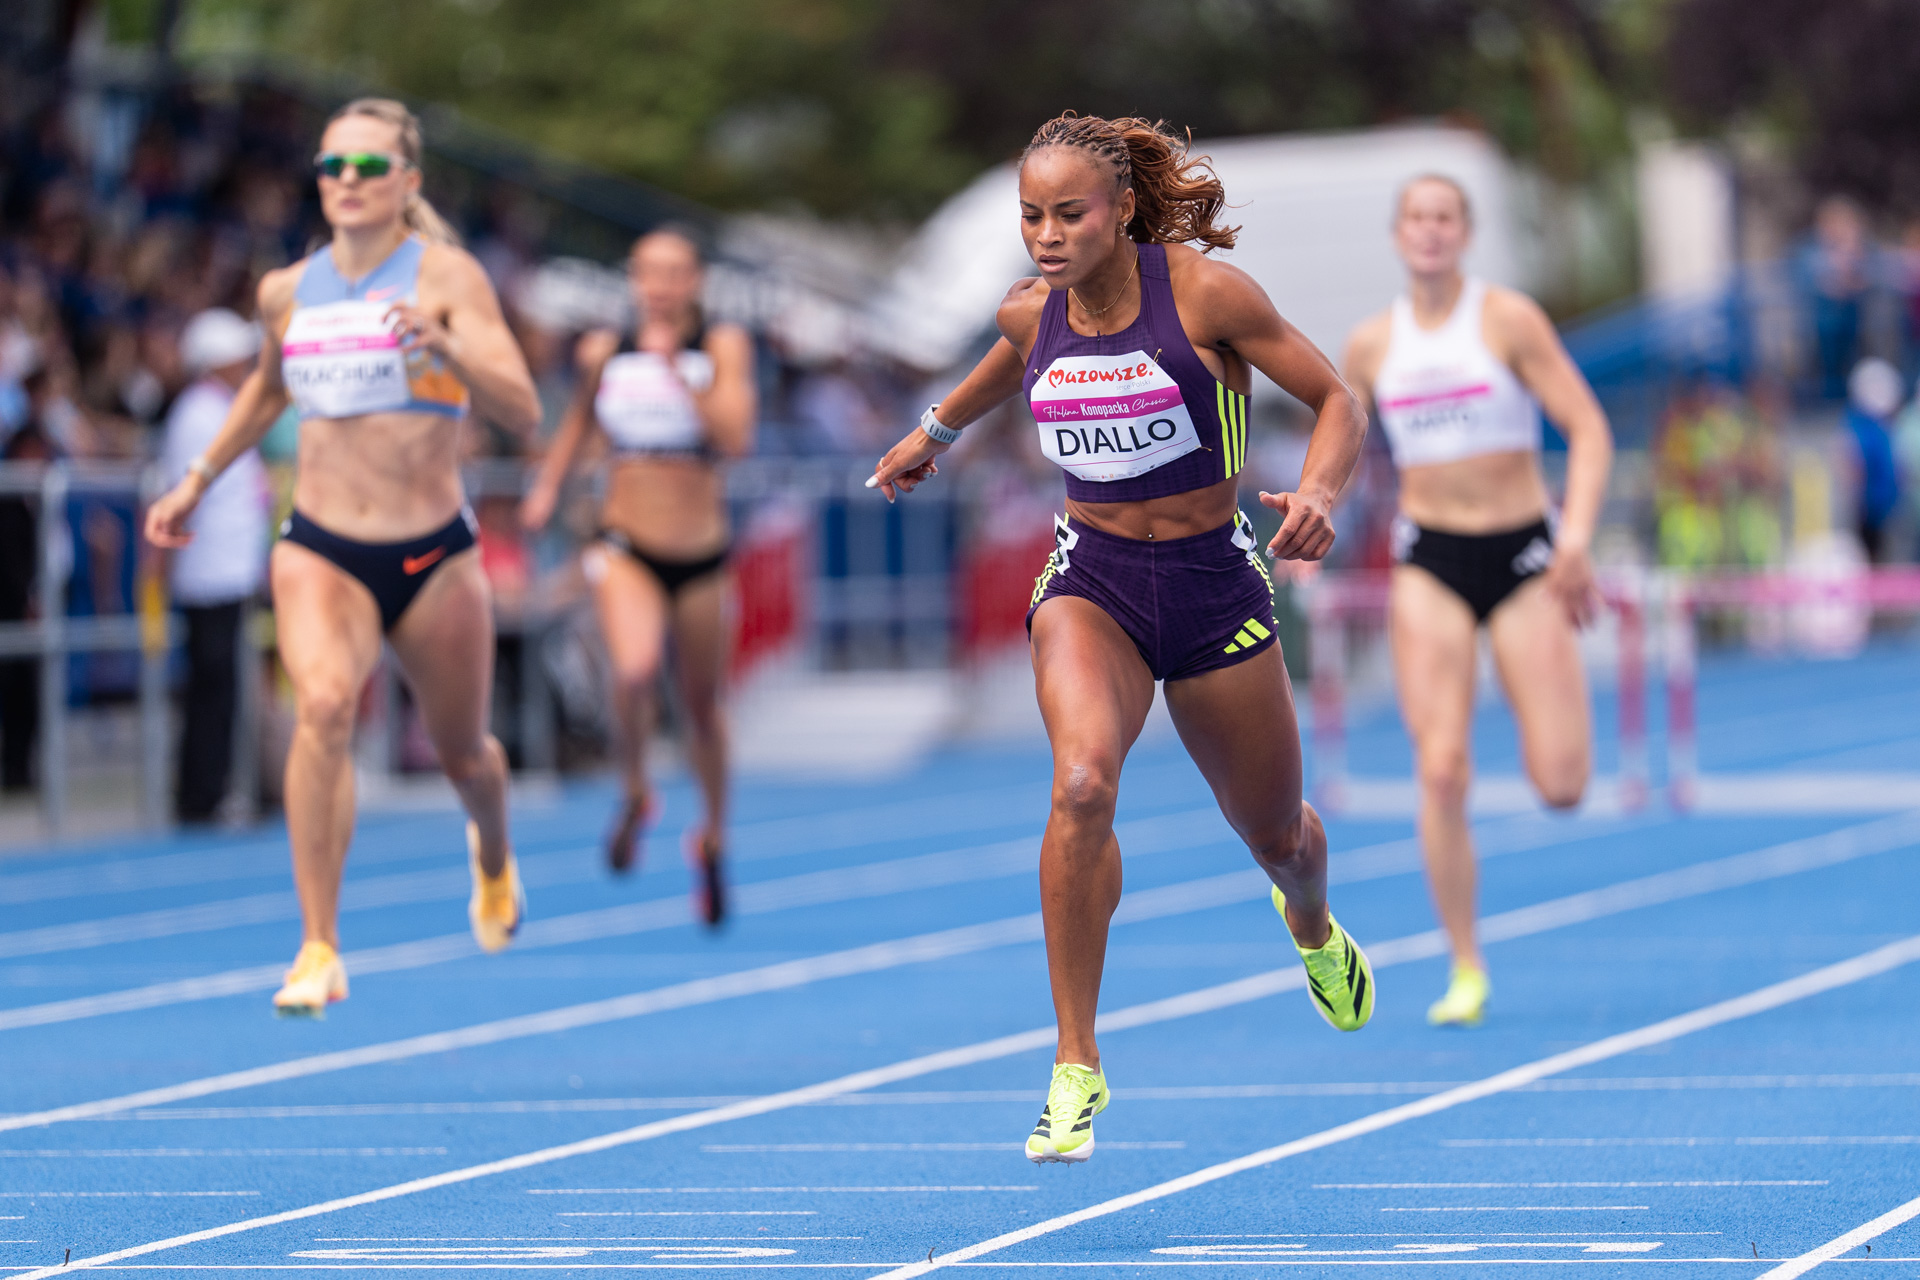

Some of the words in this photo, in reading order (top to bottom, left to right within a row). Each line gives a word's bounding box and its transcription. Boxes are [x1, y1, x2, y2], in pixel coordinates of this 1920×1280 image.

[1043, 405, 1079, 420] Halina
[1080, 401, 1130, 417] Konopacka
[1132, 398, 1168, 411] Classic
[1055, 418, 1177, 457] DIALLO
